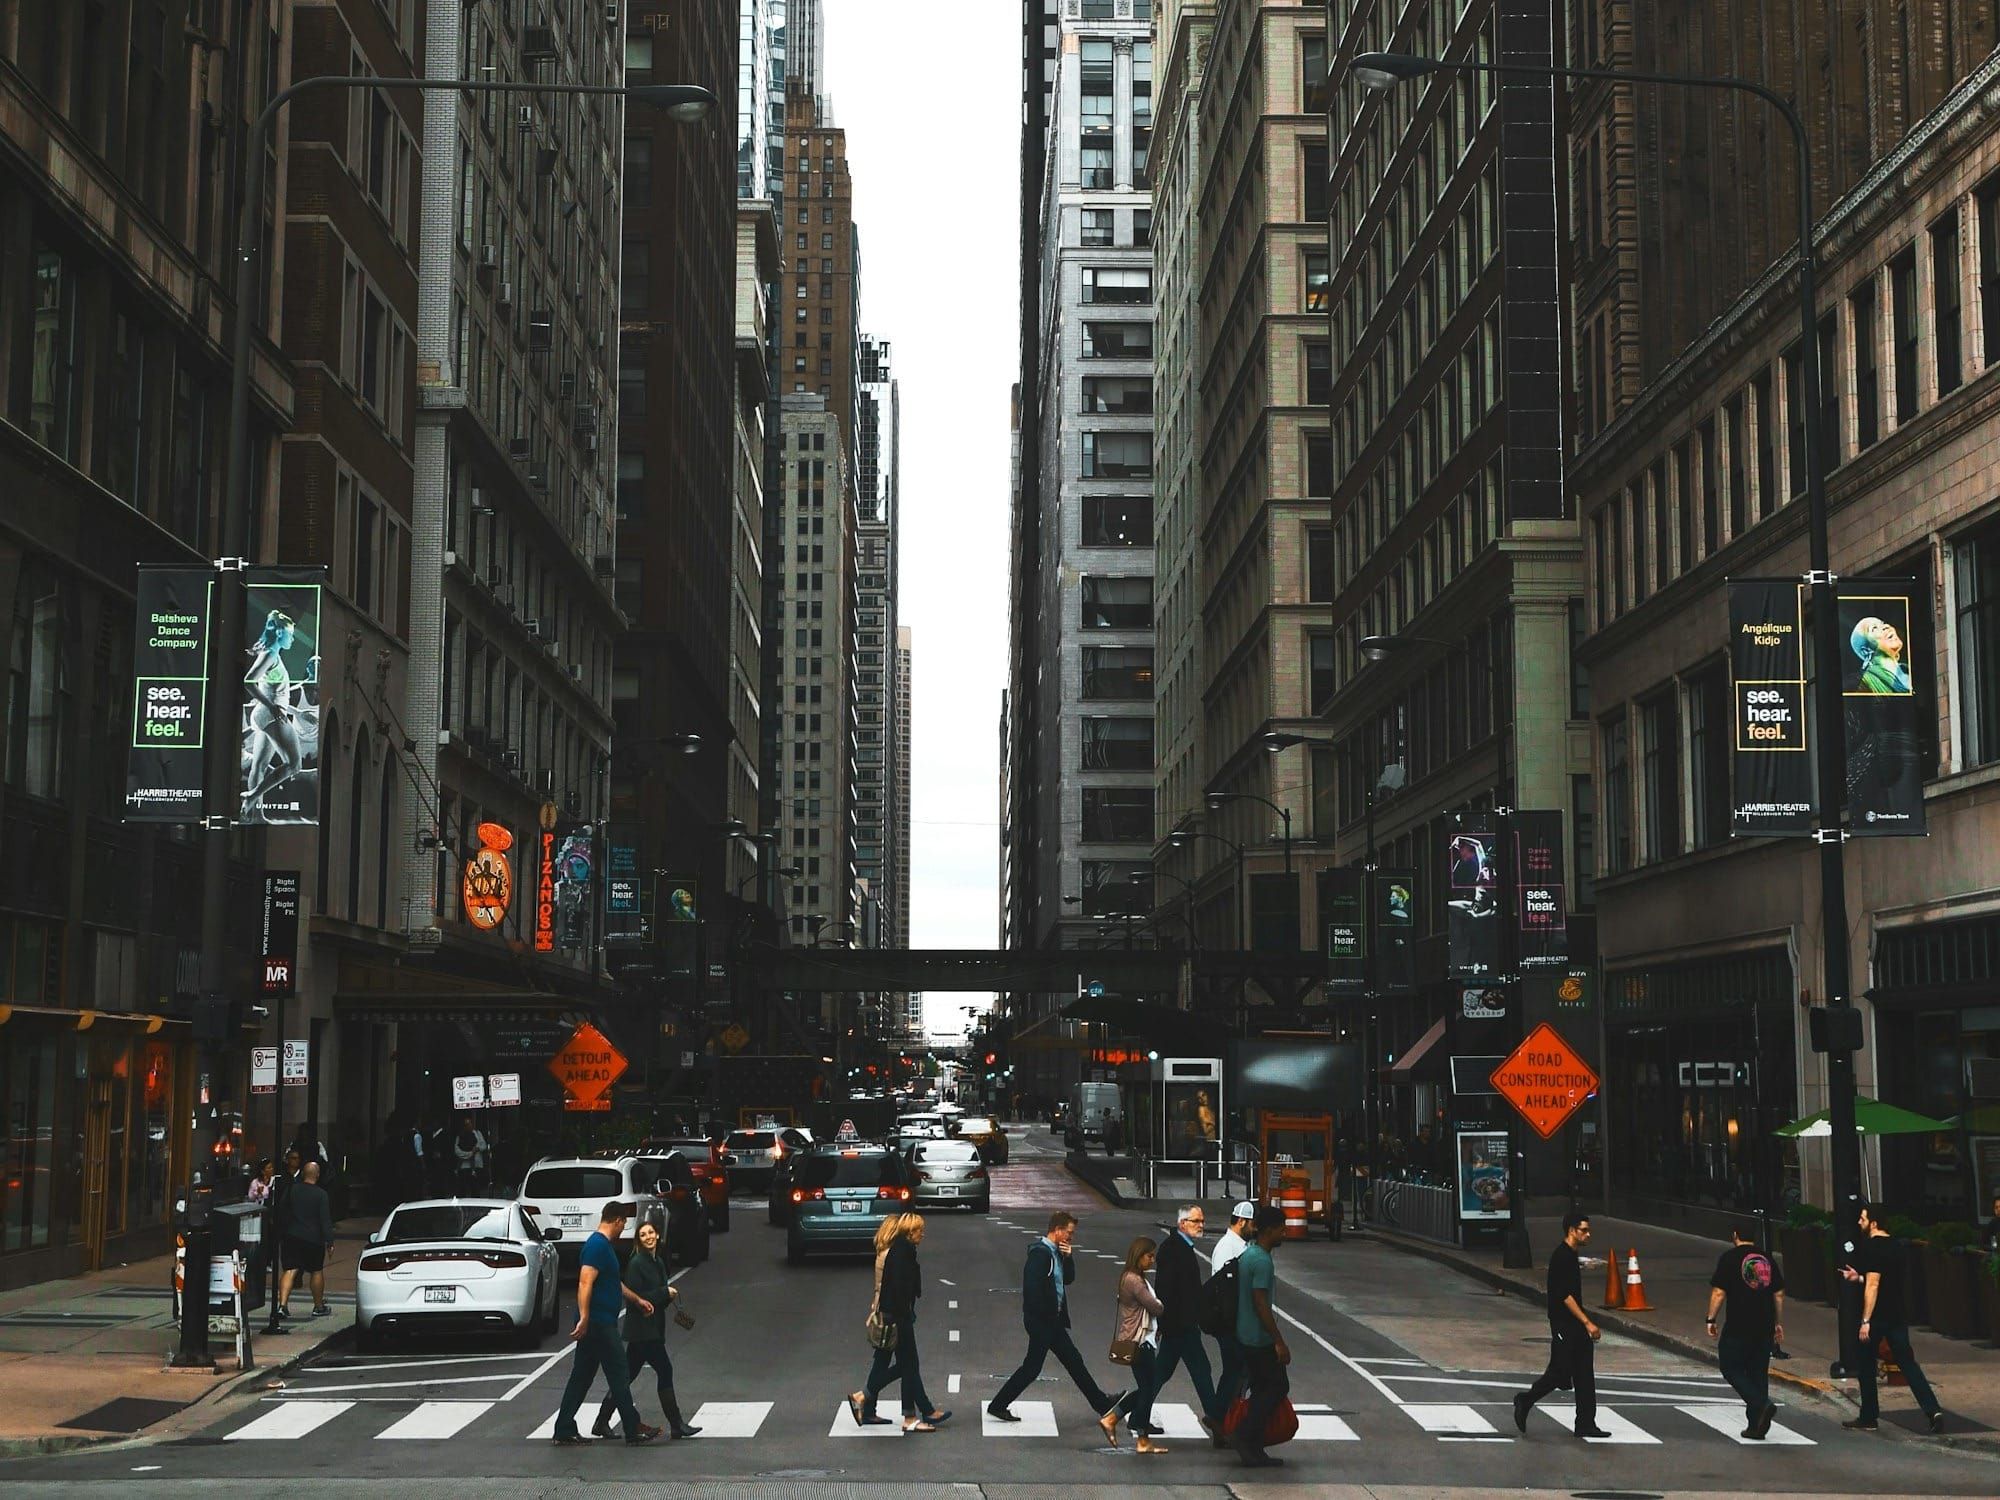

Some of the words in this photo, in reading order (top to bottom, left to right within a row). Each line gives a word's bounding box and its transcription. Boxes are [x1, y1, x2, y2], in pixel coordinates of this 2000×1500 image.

[151, 613, 198, 624] Batsheva
[158, 626, 190, 636] Dance
[1742, 623, 1792, 635] Angélique
[149, 638, 198, 649] Company
[1754, 635, 1780, 647] Kidjo
[147, 686, 186, 701] see.
[1747, 690, 1785, 704] see.
[146, 702, 191, 719] hear.
[1747, 705, 1792, 722] hear.
[145, 720, 184, 737] feel.
[1747, 723, 1786, 740] feel.
[137, 788, 168, 798] HARRIS
[168, 789, 202, 798] THEATER
[1745, 803, 1775, 812] HARRIS
[1775, 803, 1810, 812] THEATER
[277, 878, 295, 887] Right
[538, 833, 554, 930] PIZANOS
[612, 890, 634, 899] hear.
[1526, 890, 1552, 900] see.
[276, 901, 294, 909] Right
[612, 900, 631, 908] feel.
[1527, 900, 1556, 912] hear.
[1528, 912, 1552, 923] feel.
[1334, 936, 1356, 944] hear.
[266, 966, 288, 982] MR
[562, 1052, 611, 1065] DETOUR
[1528, 1054, 1562, 1066] ROAD
[566, 1069, 610, 1082] AHEAD
[1500, 1073, 1591, 1088] CONSTRUCTION
[1525, 1095, 1567, 1110] AHEAD
